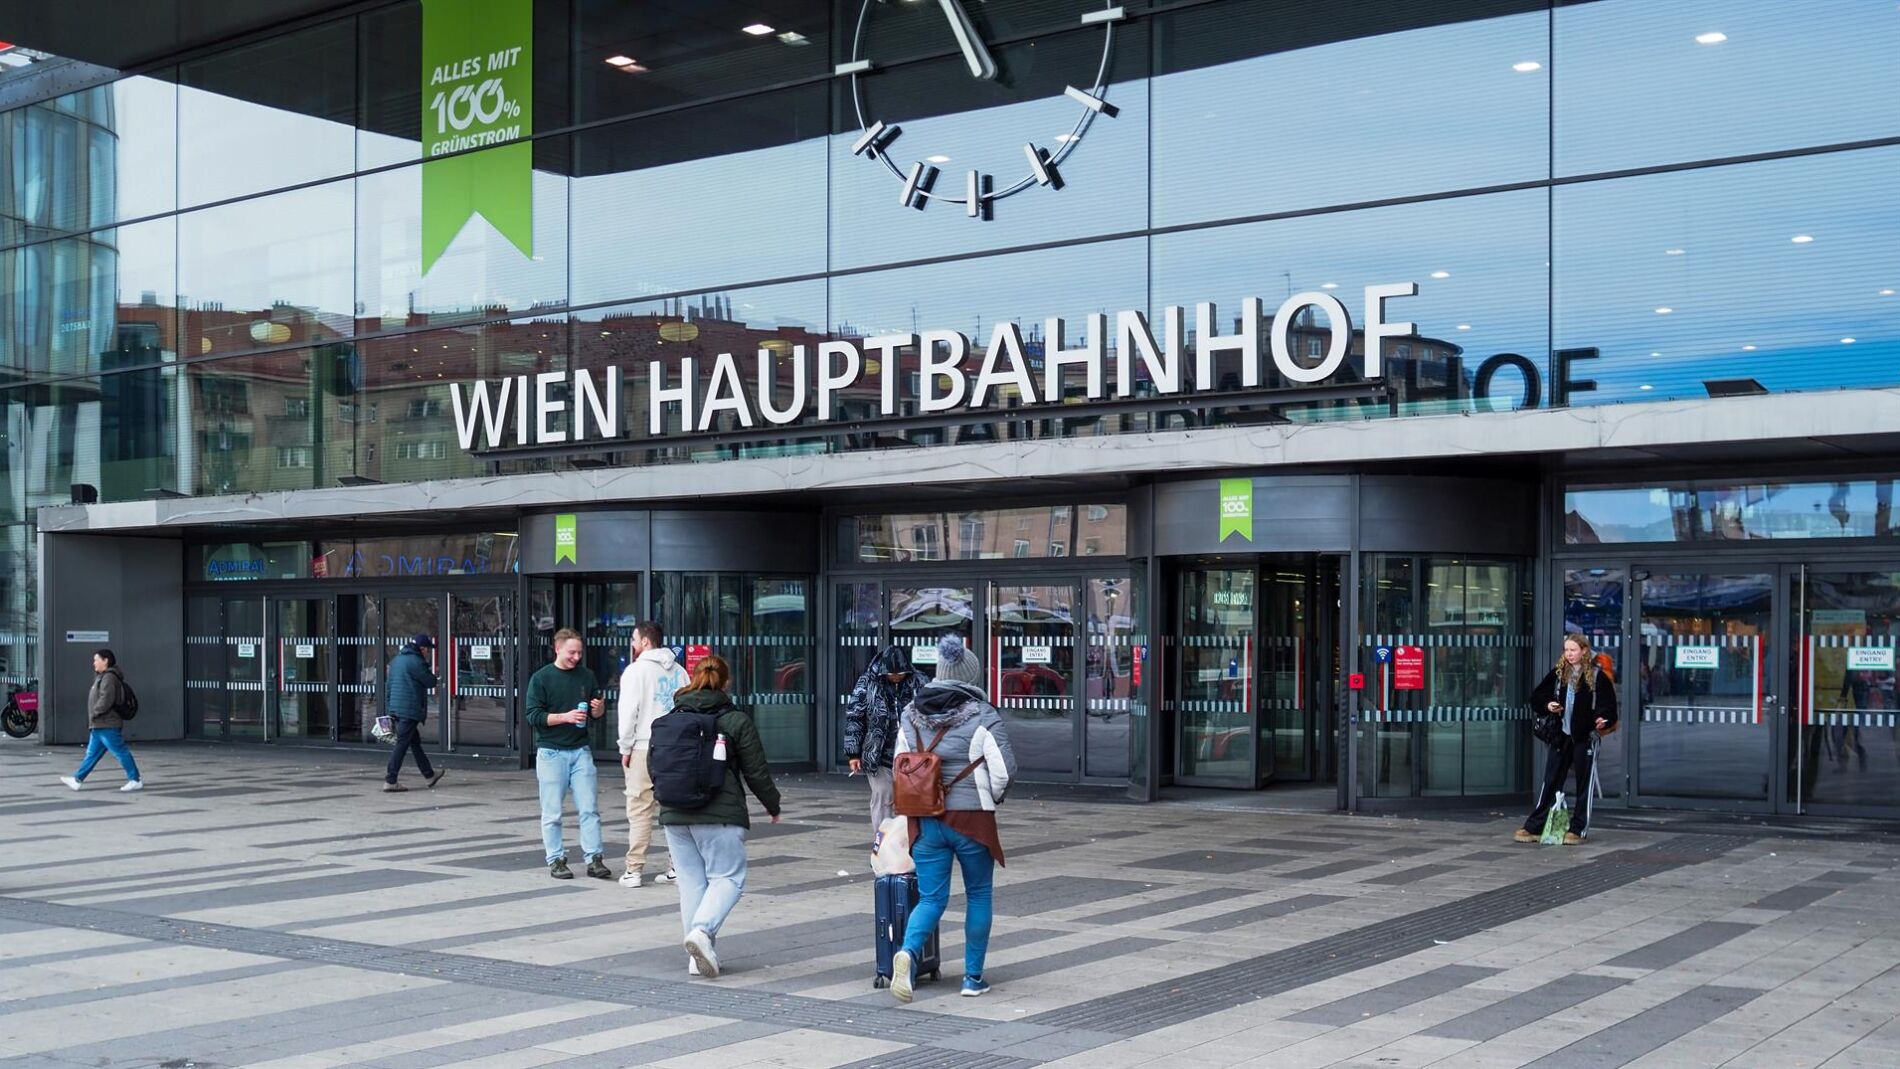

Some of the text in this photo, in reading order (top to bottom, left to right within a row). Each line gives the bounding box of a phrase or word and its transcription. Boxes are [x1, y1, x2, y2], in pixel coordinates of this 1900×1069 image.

[430, 46, 522, 86] ALLES MIT
[429, 77, 521, 134] 100%
[431, 125, 521, 157] GRÜNSTROM
[450, 282, 1419, 450] WIEN HAUPTBAHNHOF
